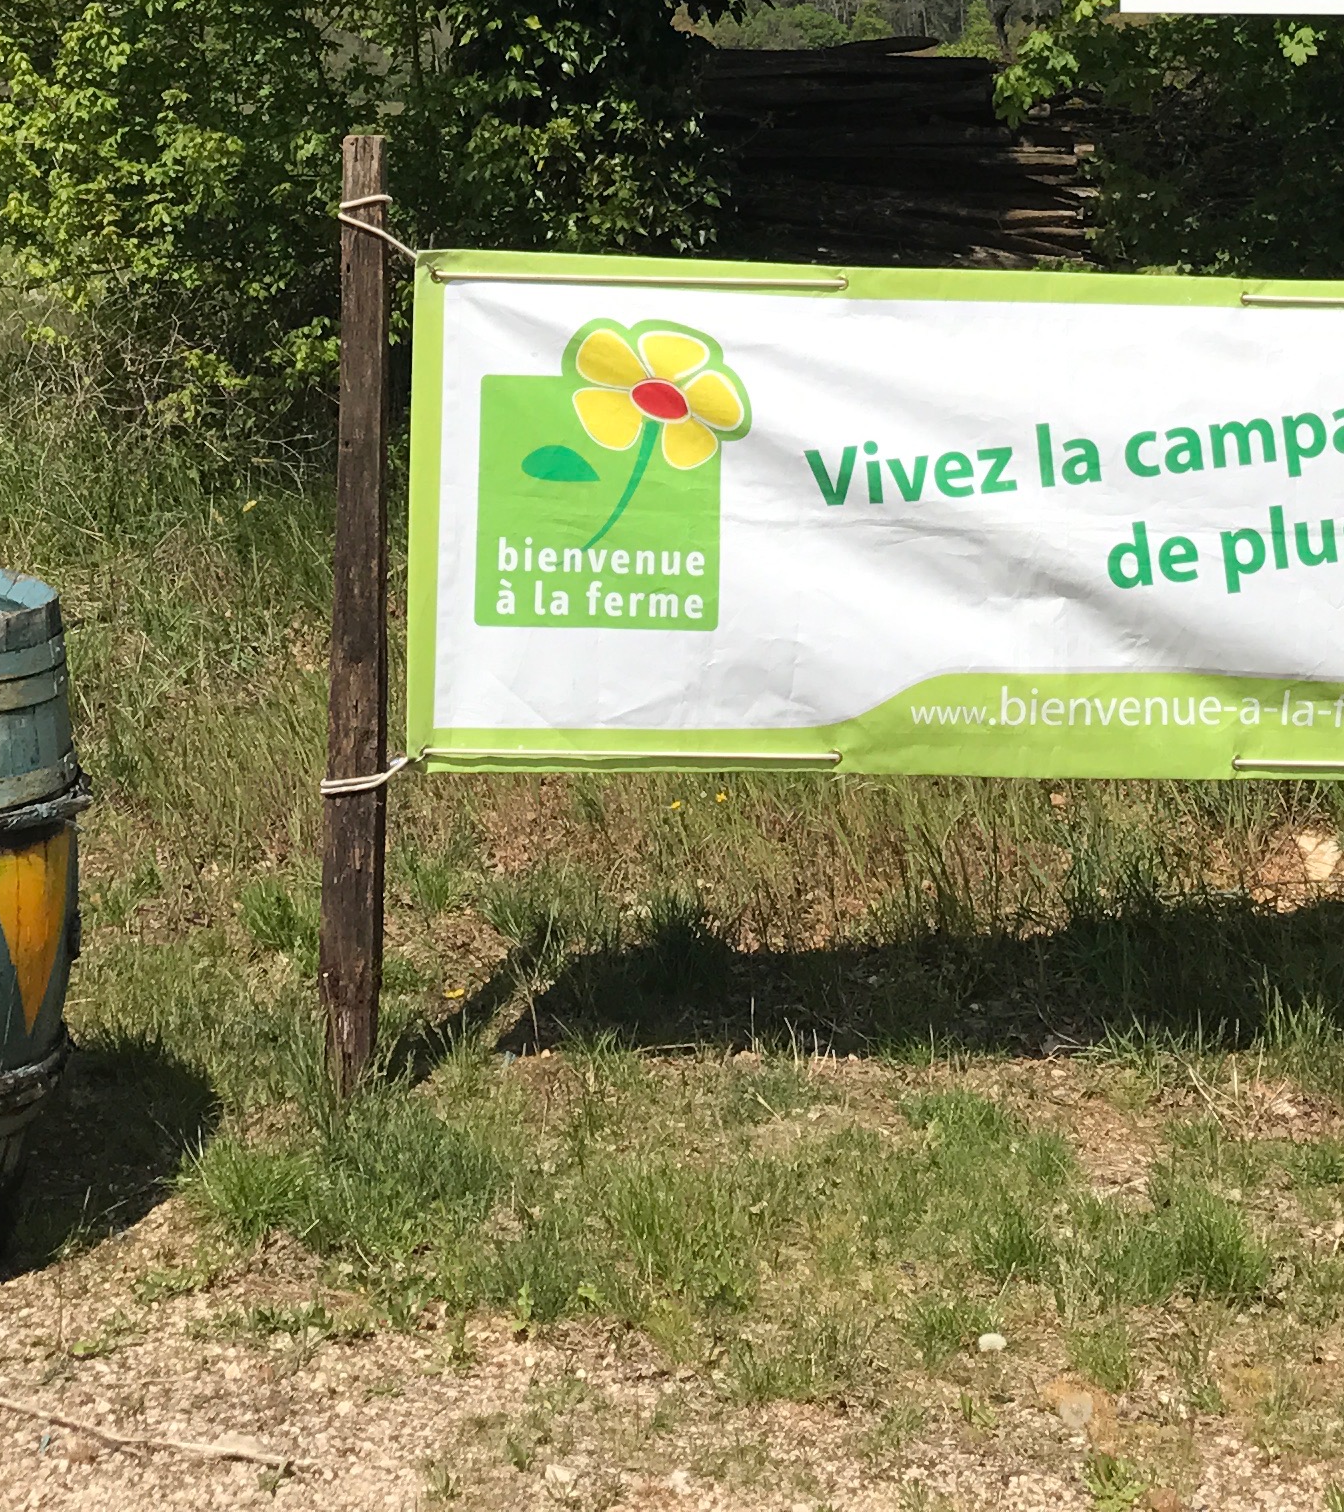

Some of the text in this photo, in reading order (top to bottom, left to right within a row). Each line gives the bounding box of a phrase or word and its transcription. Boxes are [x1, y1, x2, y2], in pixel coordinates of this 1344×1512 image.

[803, 440, 1018, 507] Vivez
[1035, 423, 1103, 488] la
[497, 536, 705, 576] bienvenue
[1107, 521, 1199, 590] de
[495, 578, 704, 619] à la ferme
